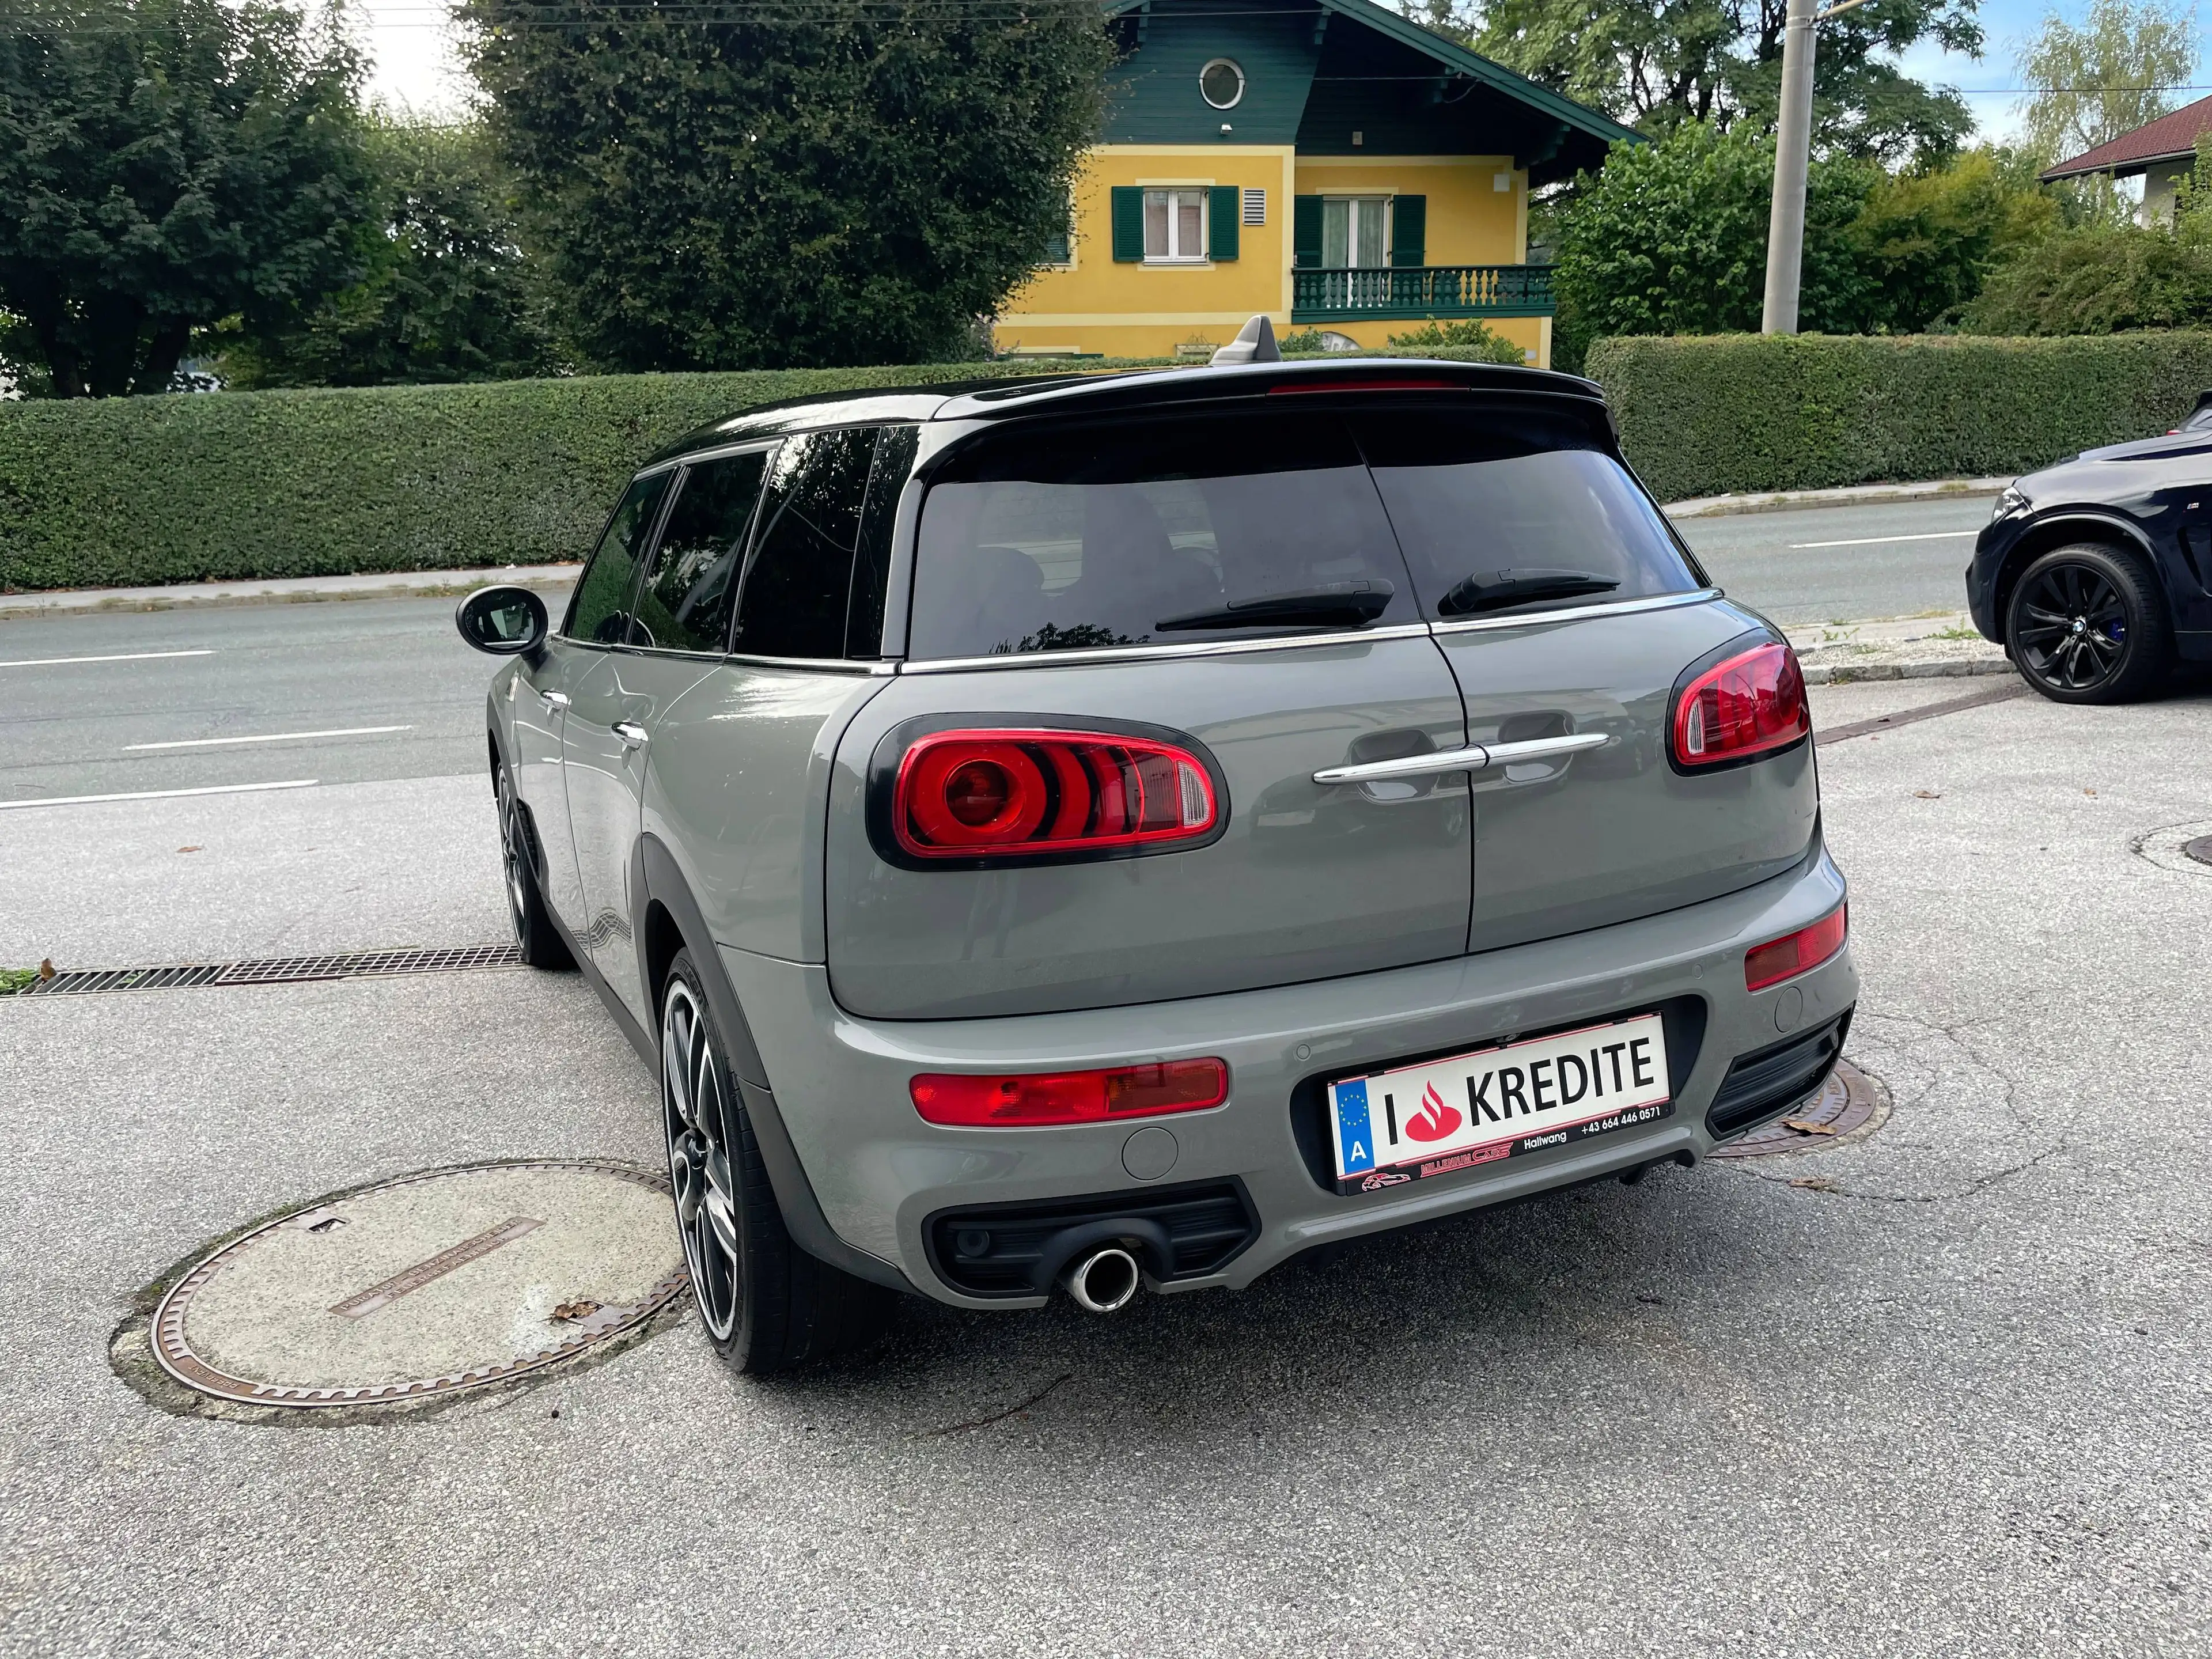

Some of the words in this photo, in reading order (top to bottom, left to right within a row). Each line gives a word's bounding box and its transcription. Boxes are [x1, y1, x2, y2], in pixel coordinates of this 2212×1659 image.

[1384, 1093, 1399, 1146] I
[1466, 1036, 1654, 1127] KREDITE
[1581, 1123, 1600, 1135] +43
[1602, 1118, 1619, 1130] 664
[1622, 1113, 1638, 1124] 446
[1639, 1107, 1660, 1120] 0571
[1350, 1141, 1367, 1162] A
[1524, 1132, 1567, 1150] Hallwang
[1421, 1153, 1472, 1175] MILLENIUM
[340, 1279, 397, 1310] PURATOR
